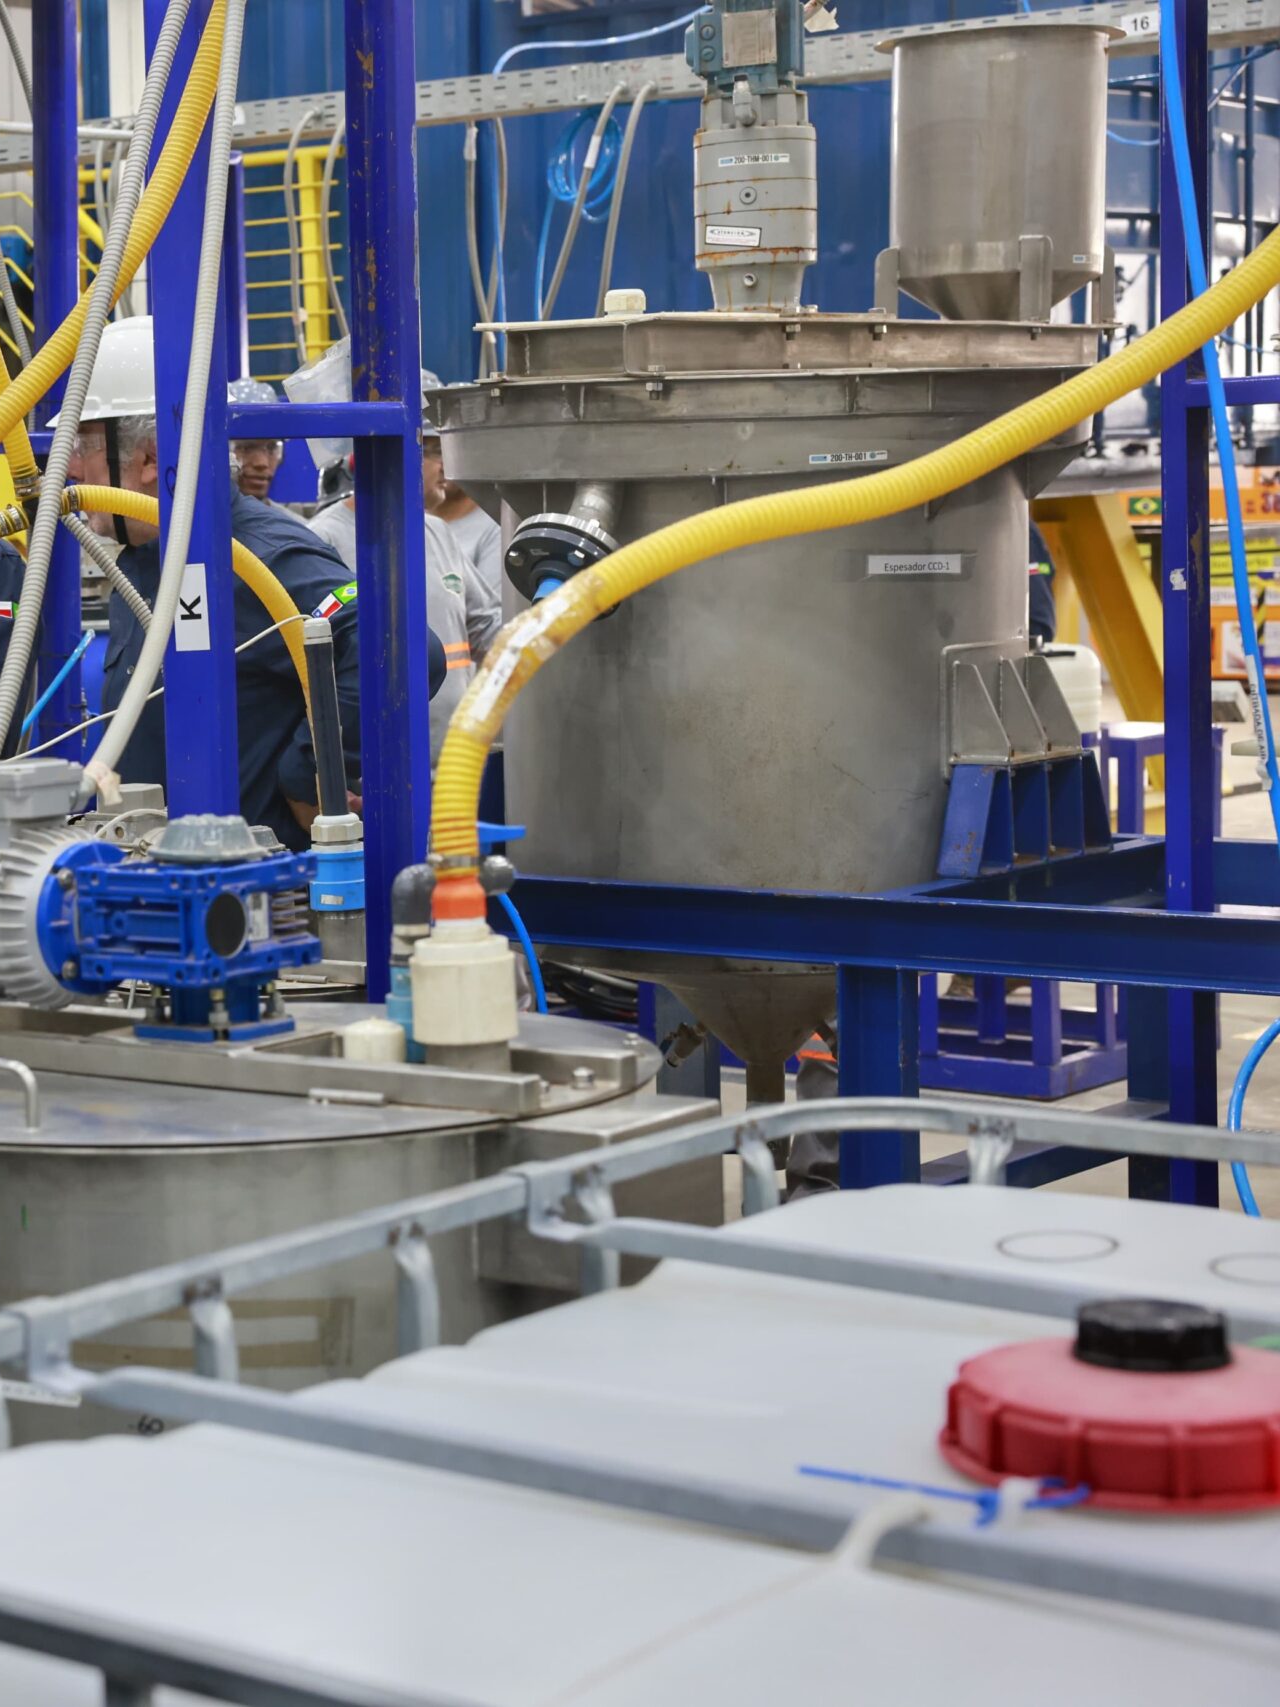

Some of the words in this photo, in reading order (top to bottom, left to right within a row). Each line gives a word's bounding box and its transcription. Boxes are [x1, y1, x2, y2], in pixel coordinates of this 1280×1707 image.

[1131, 16, 1150, 31] 16
[830, 452, 868, 462] 200-TH-001
[884, 562, 926, 573] Espesador
[927, 561, 950, 571] CCD-1
[179, 595, 202, 621] K
